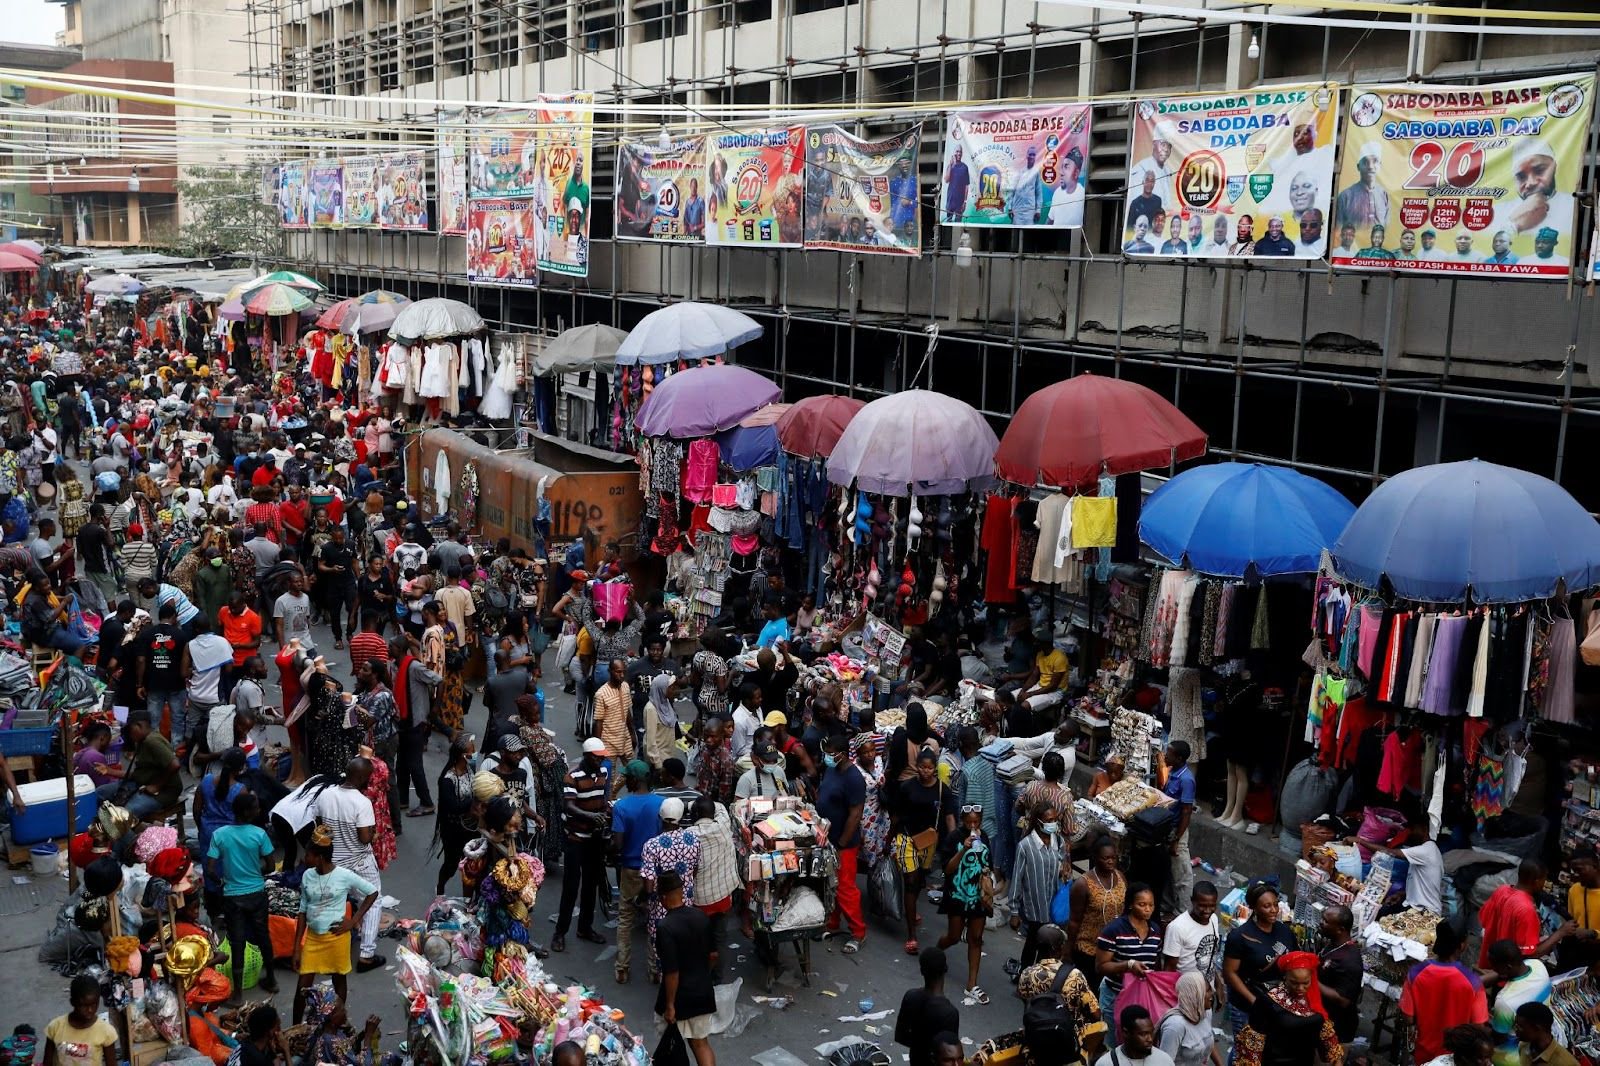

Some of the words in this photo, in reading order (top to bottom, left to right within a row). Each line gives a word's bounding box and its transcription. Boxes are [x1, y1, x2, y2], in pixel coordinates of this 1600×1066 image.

[1157, 96, 1249, 114] SABODABA
[1256, 91, 1306, 106] BASE
[1386, 91, 1484, 110] SABODABA
[1490, 88, 1541, 106] BASE
[968, 119, 1027, 135] SABODABA
[1031, 116, 1064, 132] BASE
[1177, 113, 1290, 134] SABODABA
[1383, 118, 1497, 139] SABODABA
[1500, 115, 1547, 137] DAY
[1210, 133, 1250, 148] DAY
[1403, 140, 1486, 190] 20
[1186, 161, 1214, 193] 20
[659, 188, 673, 206] 20
[738, 176, 759, 201] 20
[1189, 193, 1210, 201] YEARS
[1437, 208, 1456, 217] 12th
[1467, 207, 1489, 218] 4pm
[1350, 258, 1393, 268] Courtesy:
[1394, 260, 1417, 268] OMO
[1418, 261, 1444, 270] FASH
[1470, 264, 1500, 272] BABA
[1504, 265, 1539, 273] TAWA
[609, 487, 625, 496] 021
